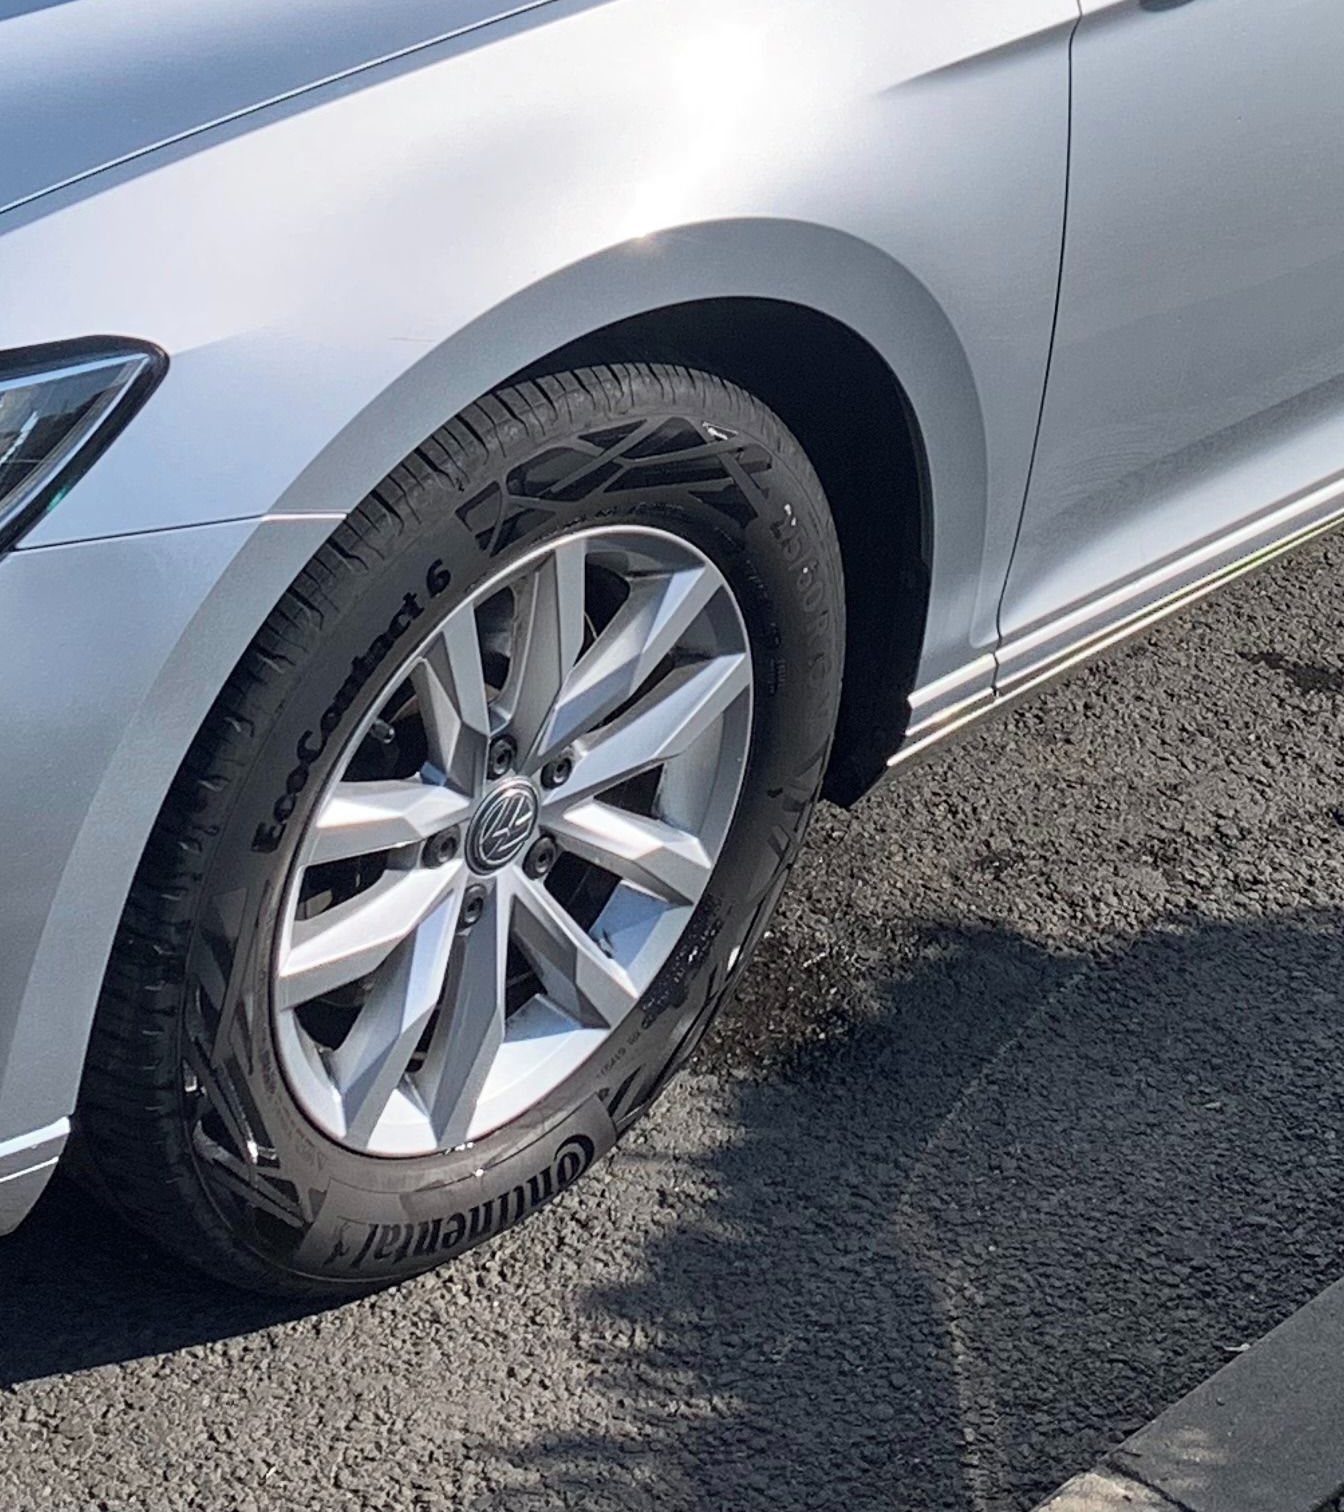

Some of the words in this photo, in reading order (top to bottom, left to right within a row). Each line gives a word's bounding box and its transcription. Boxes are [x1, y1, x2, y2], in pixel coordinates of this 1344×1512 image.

[251, 592, 424, 854] EcoContact
[426, 558, 452, 599] 6
[348, 1133, 595, 1270] Continental
